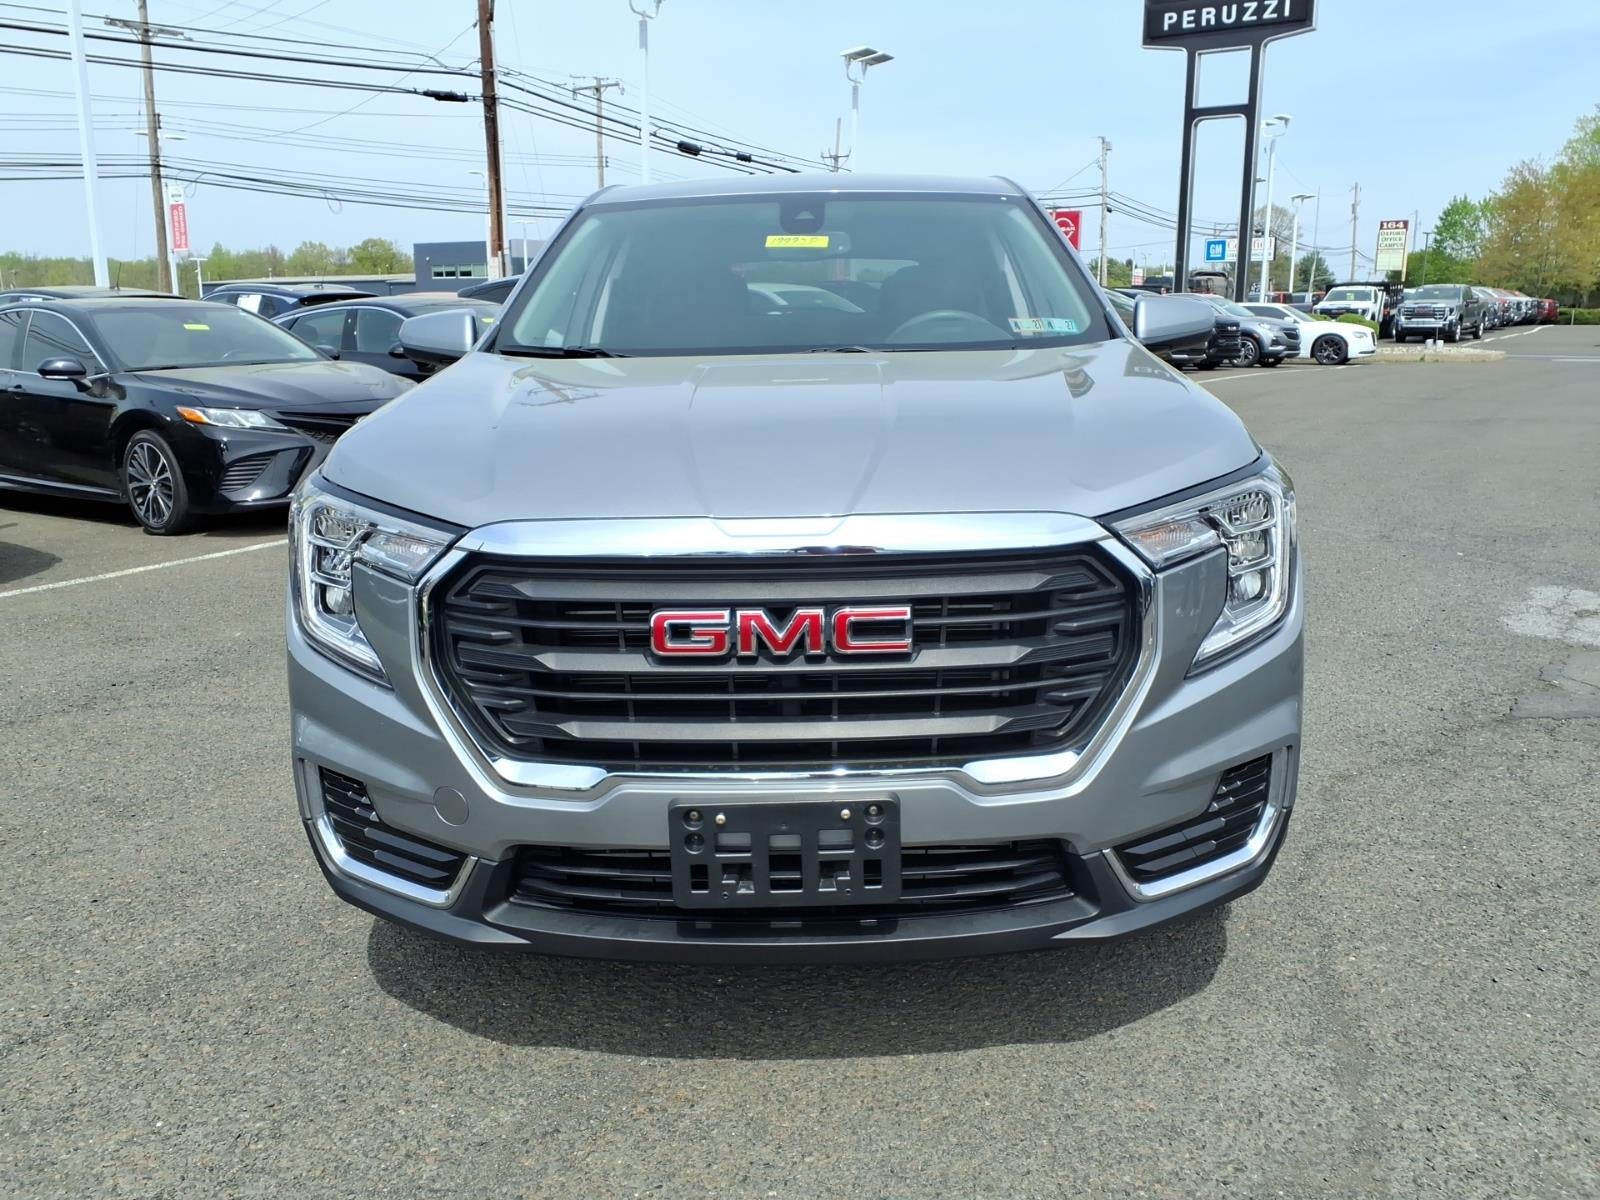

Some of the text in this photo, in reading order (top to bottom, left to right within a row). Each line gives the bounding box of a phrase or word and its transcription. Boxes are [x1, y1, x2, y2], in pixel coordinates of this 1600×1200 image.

[1163, 0, 1291, 31] PERUZZI
[1382, 221, 1404, 229] 164
[1209, 244, 1223, 254] GM
[650, 605, 912, 657] GMC
